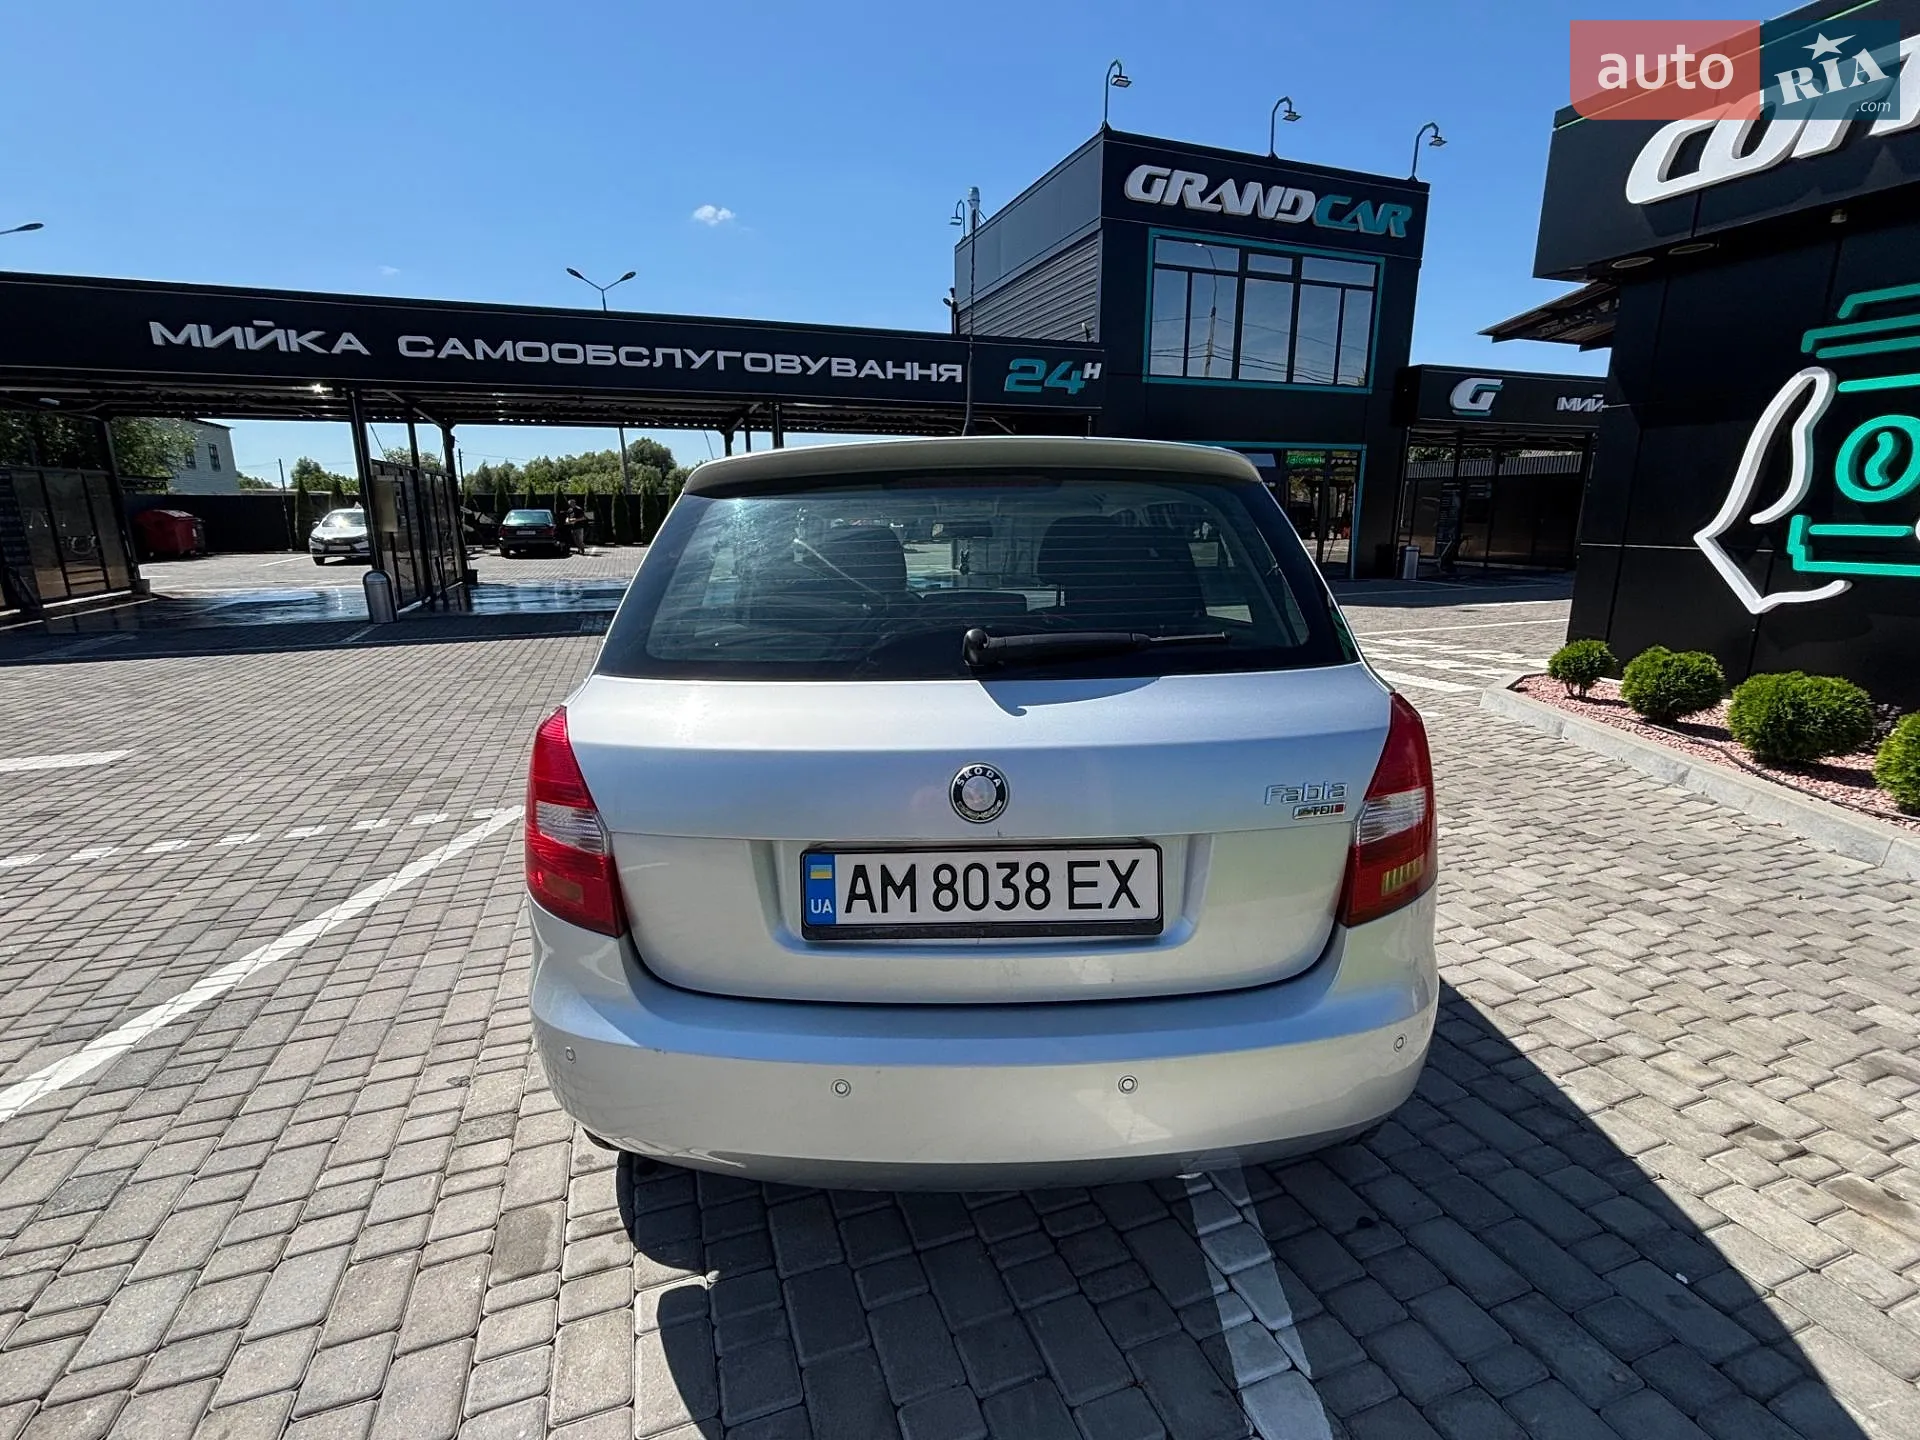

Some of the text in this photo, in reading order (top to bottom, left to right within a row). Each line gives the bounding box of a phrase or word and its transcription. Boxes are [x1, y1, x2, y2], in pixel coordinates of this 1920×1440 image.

[149, 319, 371, 356] МИЙКА
[398, 335, 963, 383] САМООБСЛУГОВУВАННЯ
[1556, 394, 1604, 412] МИЙ
[1265, 781, 1348, 804] Fabia
[845, 859, 1141, 914] AM 8038 EX
[810, 898, 833, 915] UA
